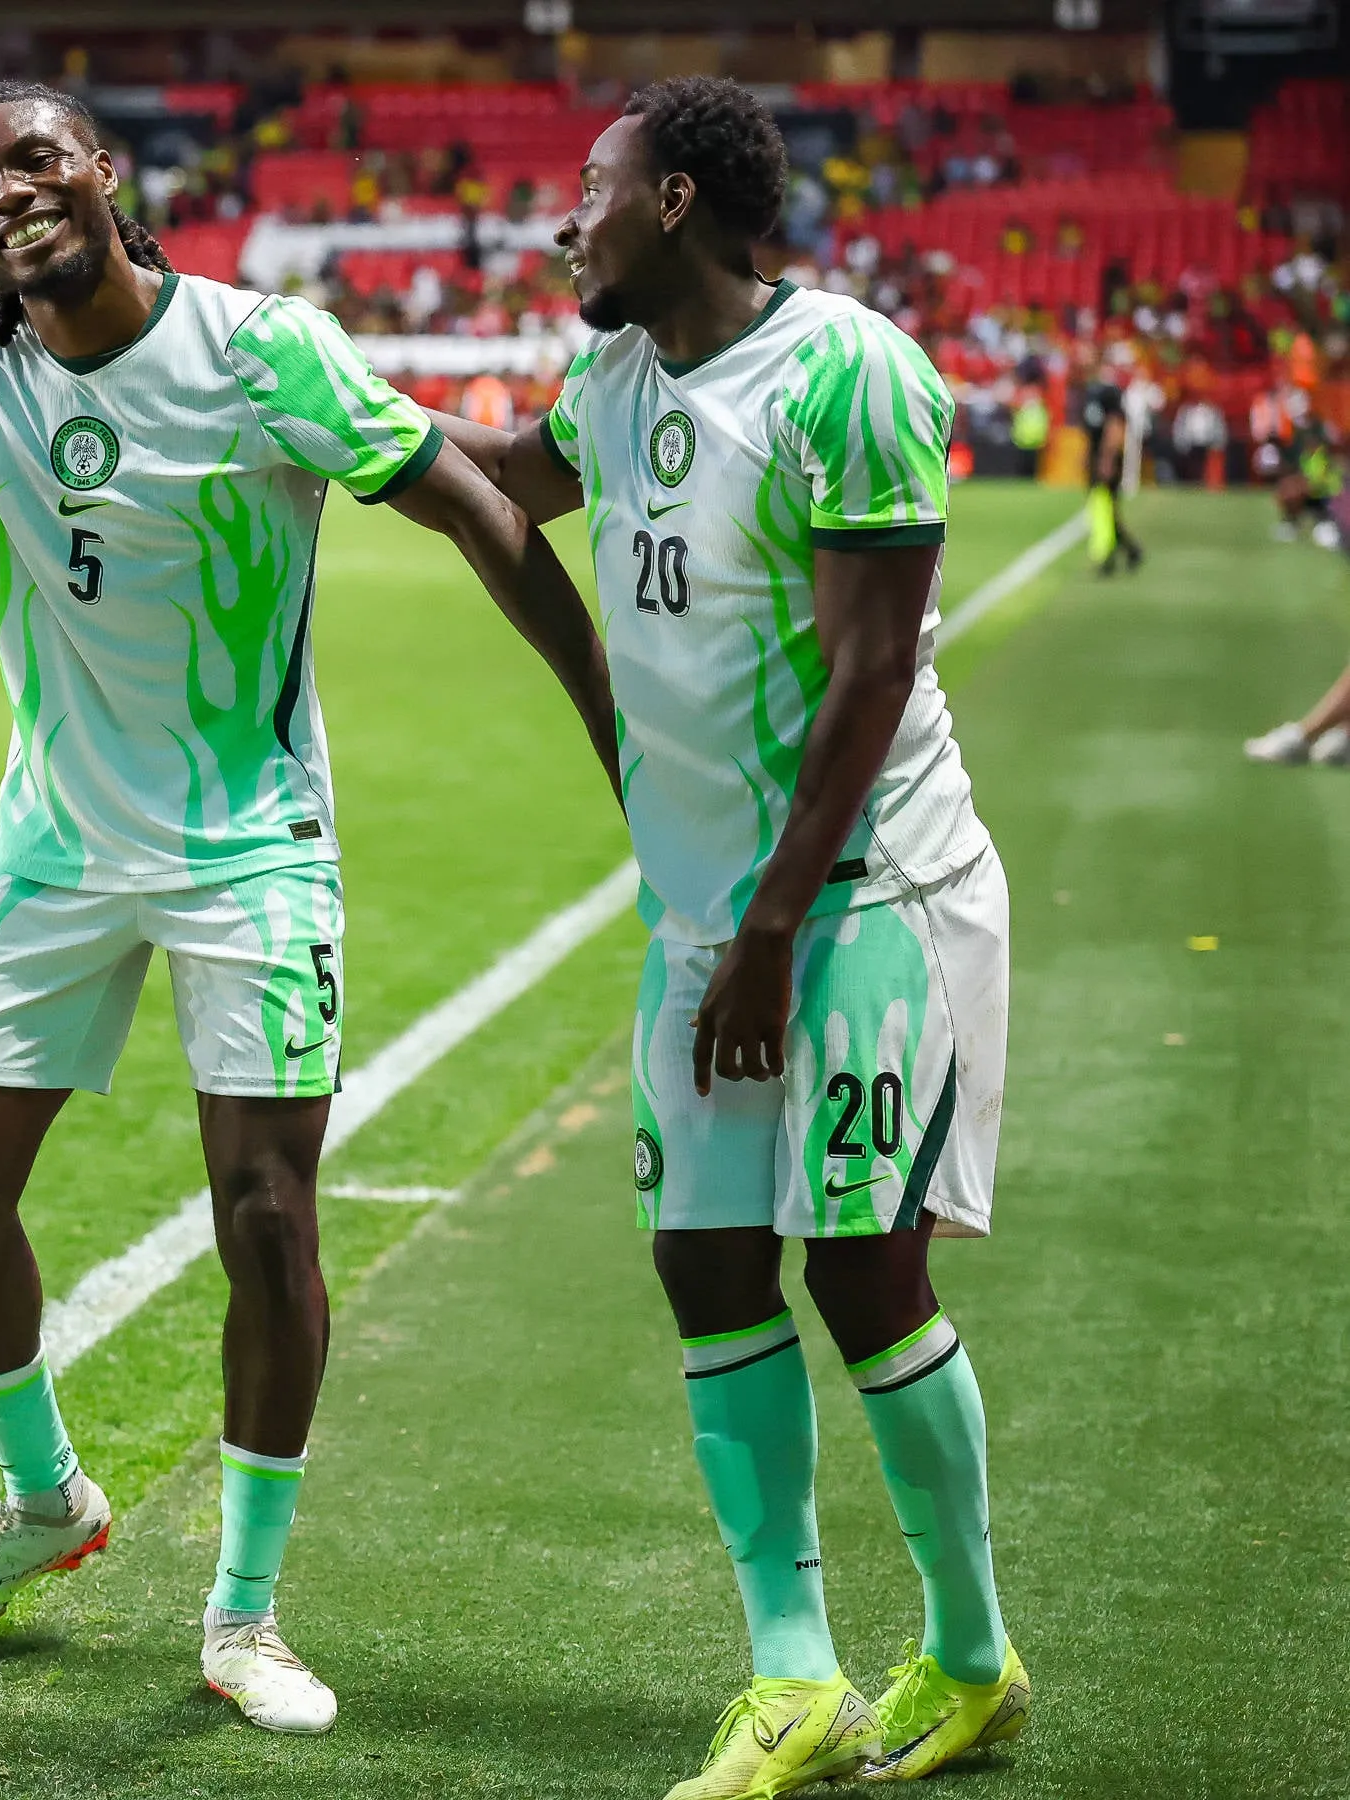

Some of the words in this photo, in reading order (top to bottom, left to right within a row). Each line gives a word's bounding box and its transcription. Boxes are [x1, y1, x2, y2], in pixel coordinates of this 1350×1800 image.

[54, 441, 65, 474] NIGERIA
[59, 421, 98, 440] FOOTBALL
[98, 427, 115, 478] FEDERATION
[73, 478, 91, 486] 1945
[67, 527, 105, 605] 5
[632, 530, 691, 618] 20
[309, 943, 338, 1025] 5
[826, 1072, 904, 1159] 20
